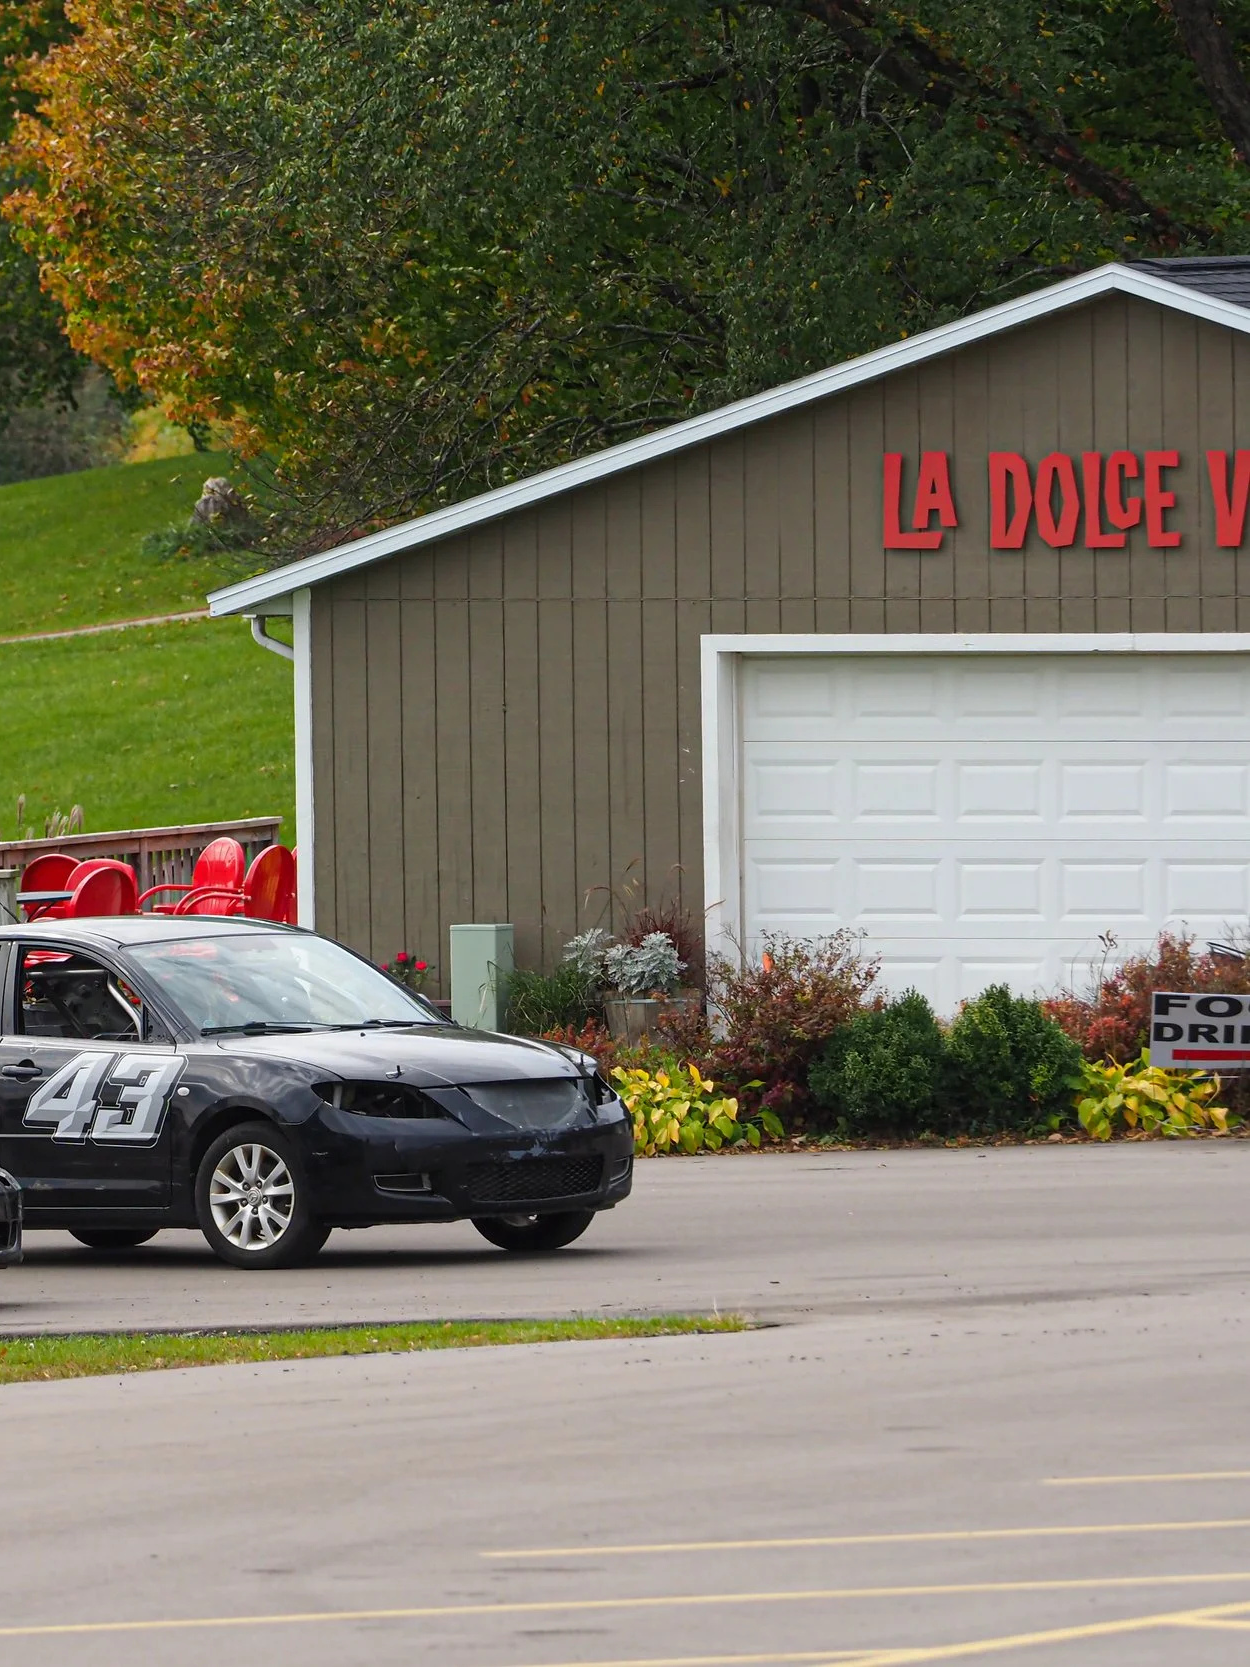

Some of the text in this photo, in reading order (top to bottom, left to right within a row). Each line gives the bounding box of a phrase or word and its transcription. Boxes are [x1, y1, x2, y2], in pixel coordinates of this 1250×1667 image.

[883, 451, 958, 549] LA
[989, 450, 1182, 549] DOLCE
[1154, 994, 1250, 1018] FO
[22, 1050, 189, 1148] 43
